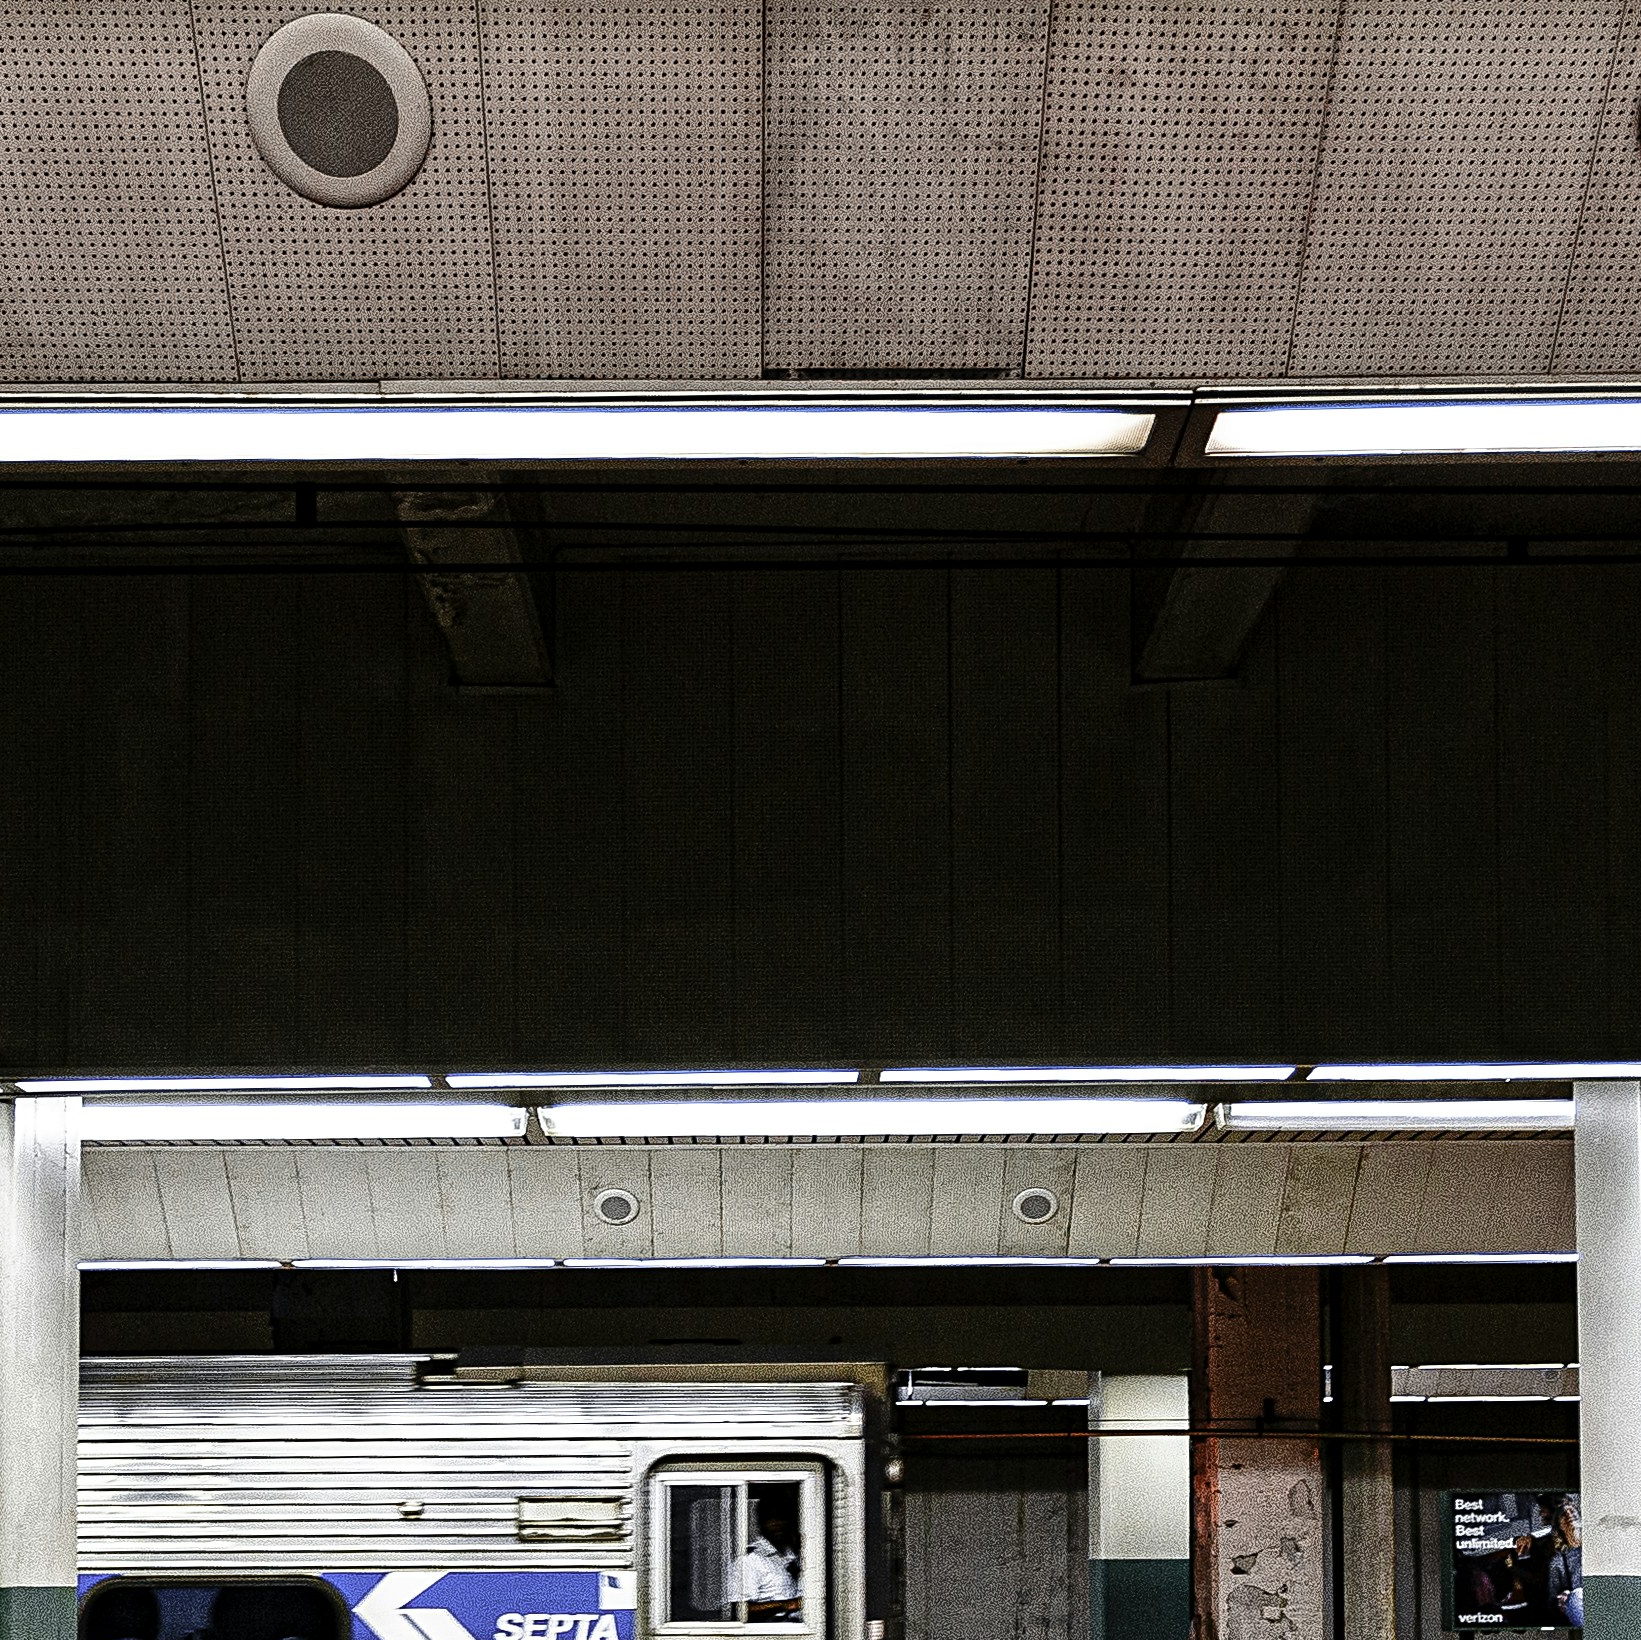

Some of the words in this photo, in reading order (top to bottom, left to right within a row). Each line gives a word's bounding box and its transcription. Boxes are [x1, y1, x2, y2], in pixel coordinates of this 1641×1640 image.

[1454, 1498, 1484, 1511] Best
[1454, 1511, 1510, 1523] network.
[1455, 1525, 1485, 1536] Best
[1456, 1538, 1517, 1550] unlimited.
[1458, 1612, 1503, 1623] verizon
